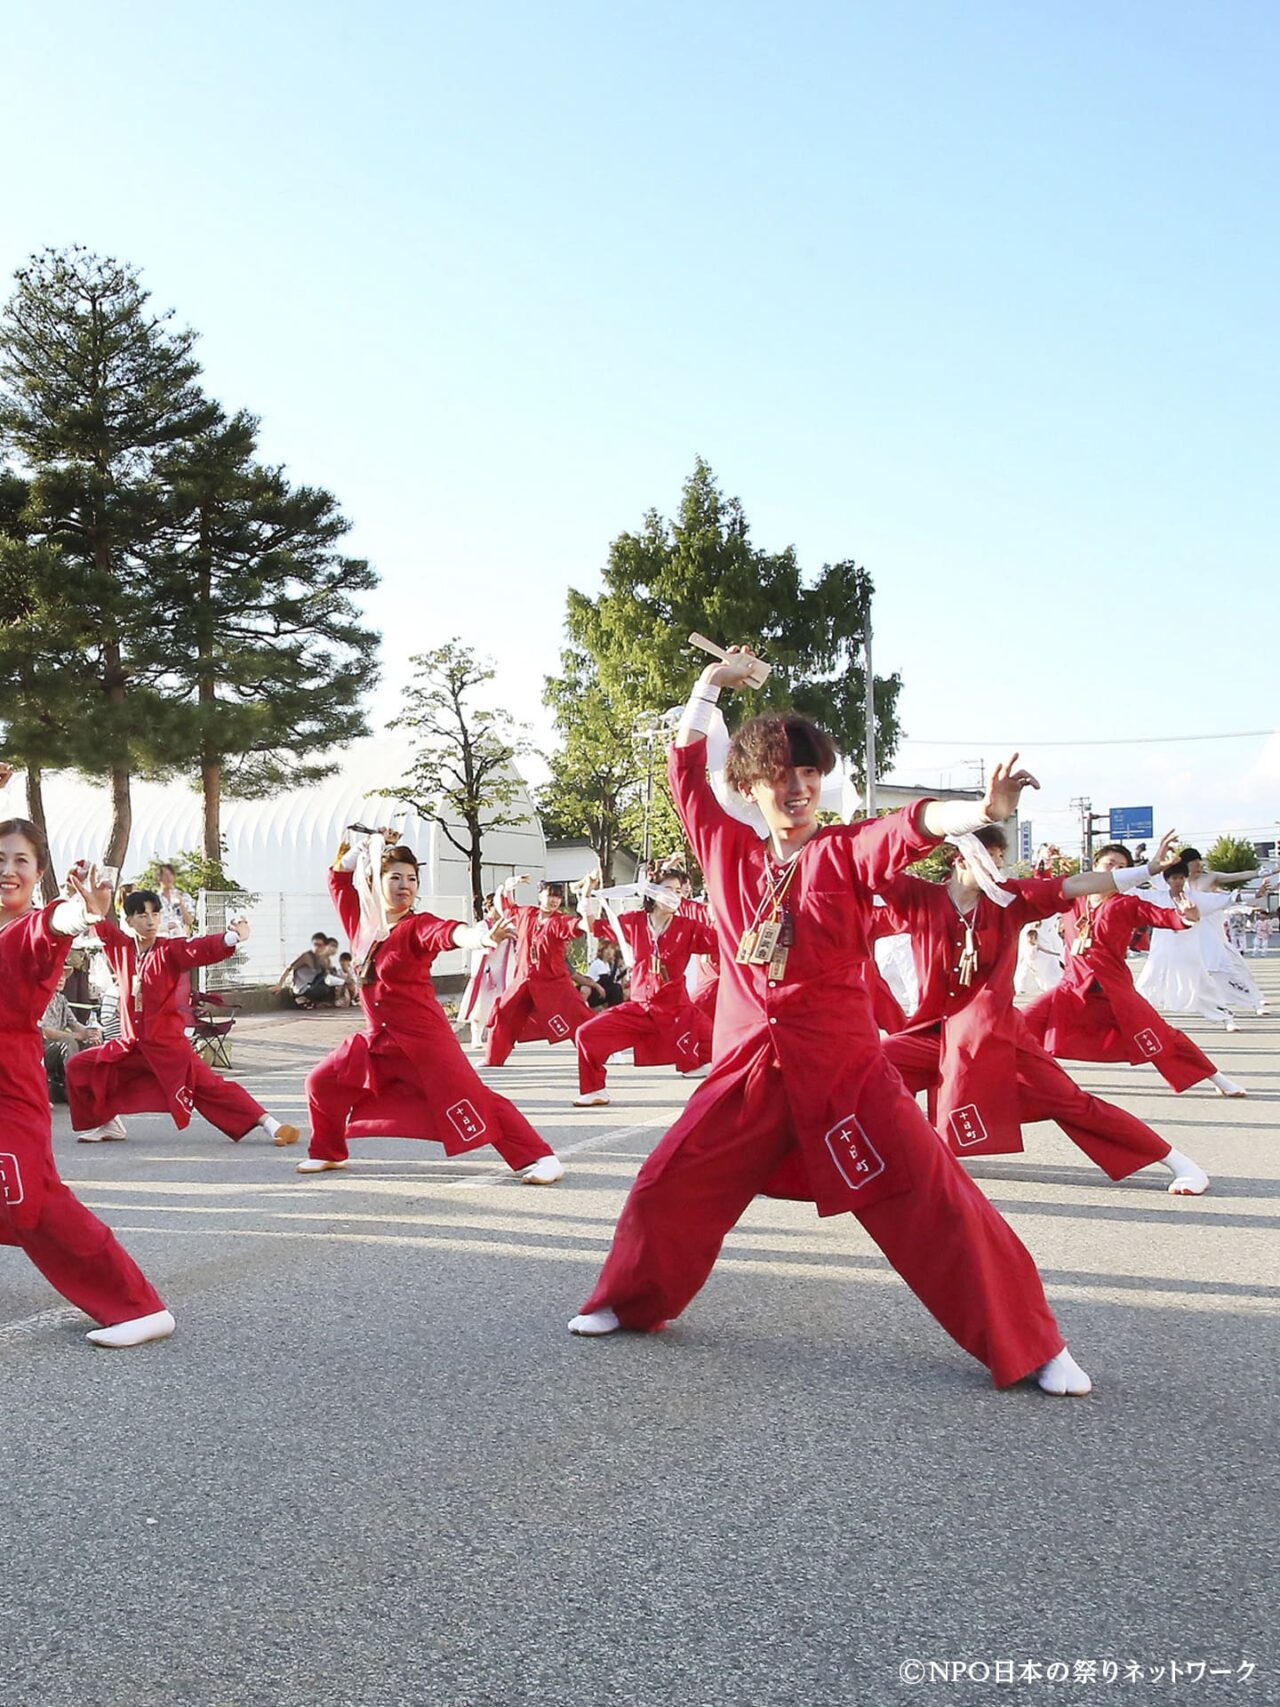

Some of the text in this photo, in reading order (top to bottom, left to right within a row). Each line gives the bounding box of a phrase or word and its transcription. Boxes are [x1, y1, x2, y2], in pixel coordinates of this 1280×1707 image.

[456, 1107, 477, 1133] 十日町
[959, 1112, 977, 1139] 十日町
[839, 1129, 870, 1173] 十日町
